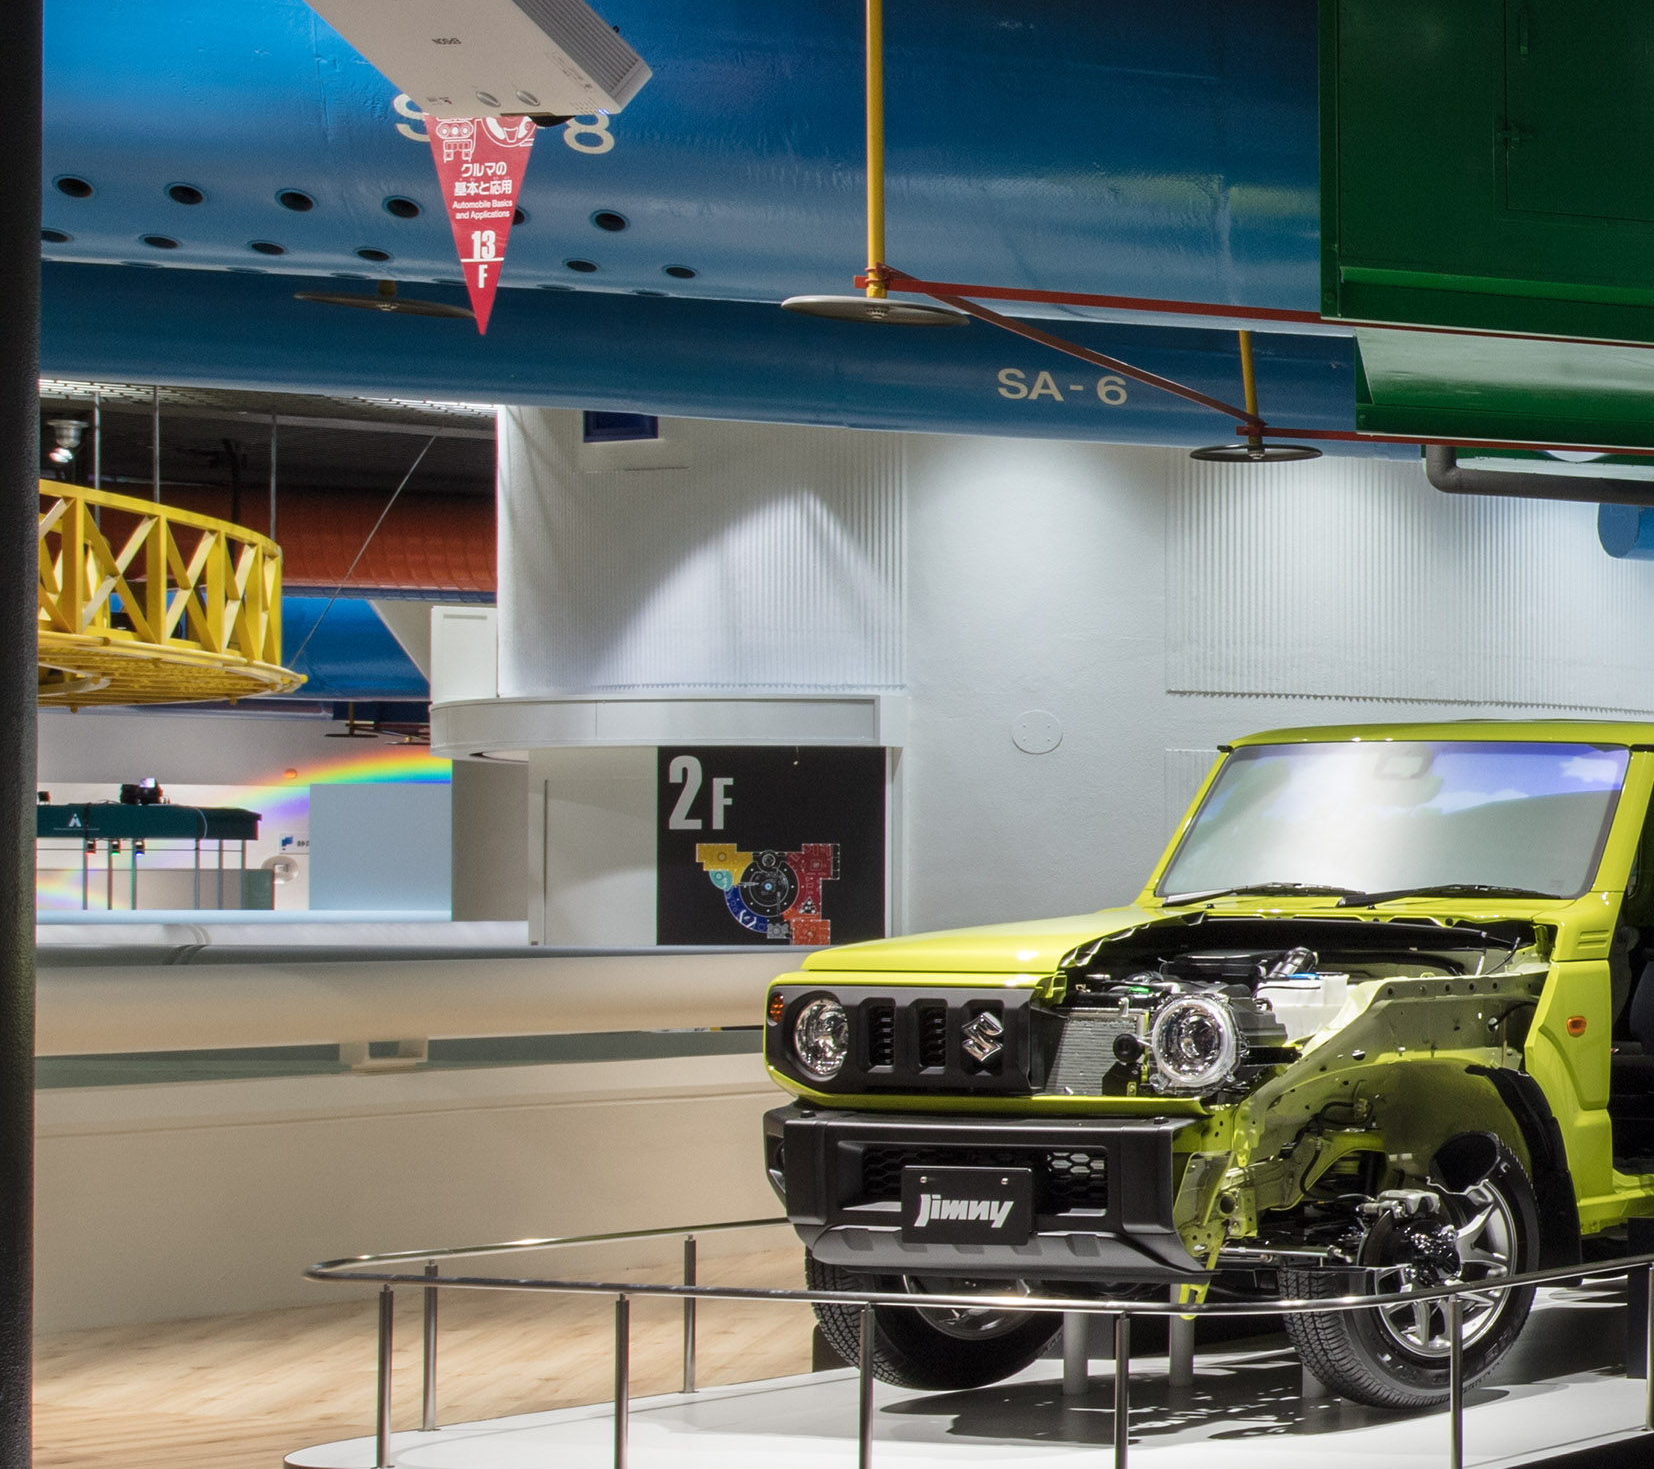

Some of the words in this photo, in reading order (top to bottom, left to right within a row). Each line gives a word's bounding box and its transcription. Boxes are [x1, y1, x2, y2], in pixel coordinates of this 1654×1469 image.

[461, 161, 508, 177] クルマの
[453, 179, 513, 197] 基本と応用
[452, 199, 492, 210] Automobile
[491, 198, 513, 208] Basics
[455, 211, 470, 220] and
[470, 209, 510, 221] Applications
[471, 230, 496, 260] 13
[478, 264, 488, 289] F
